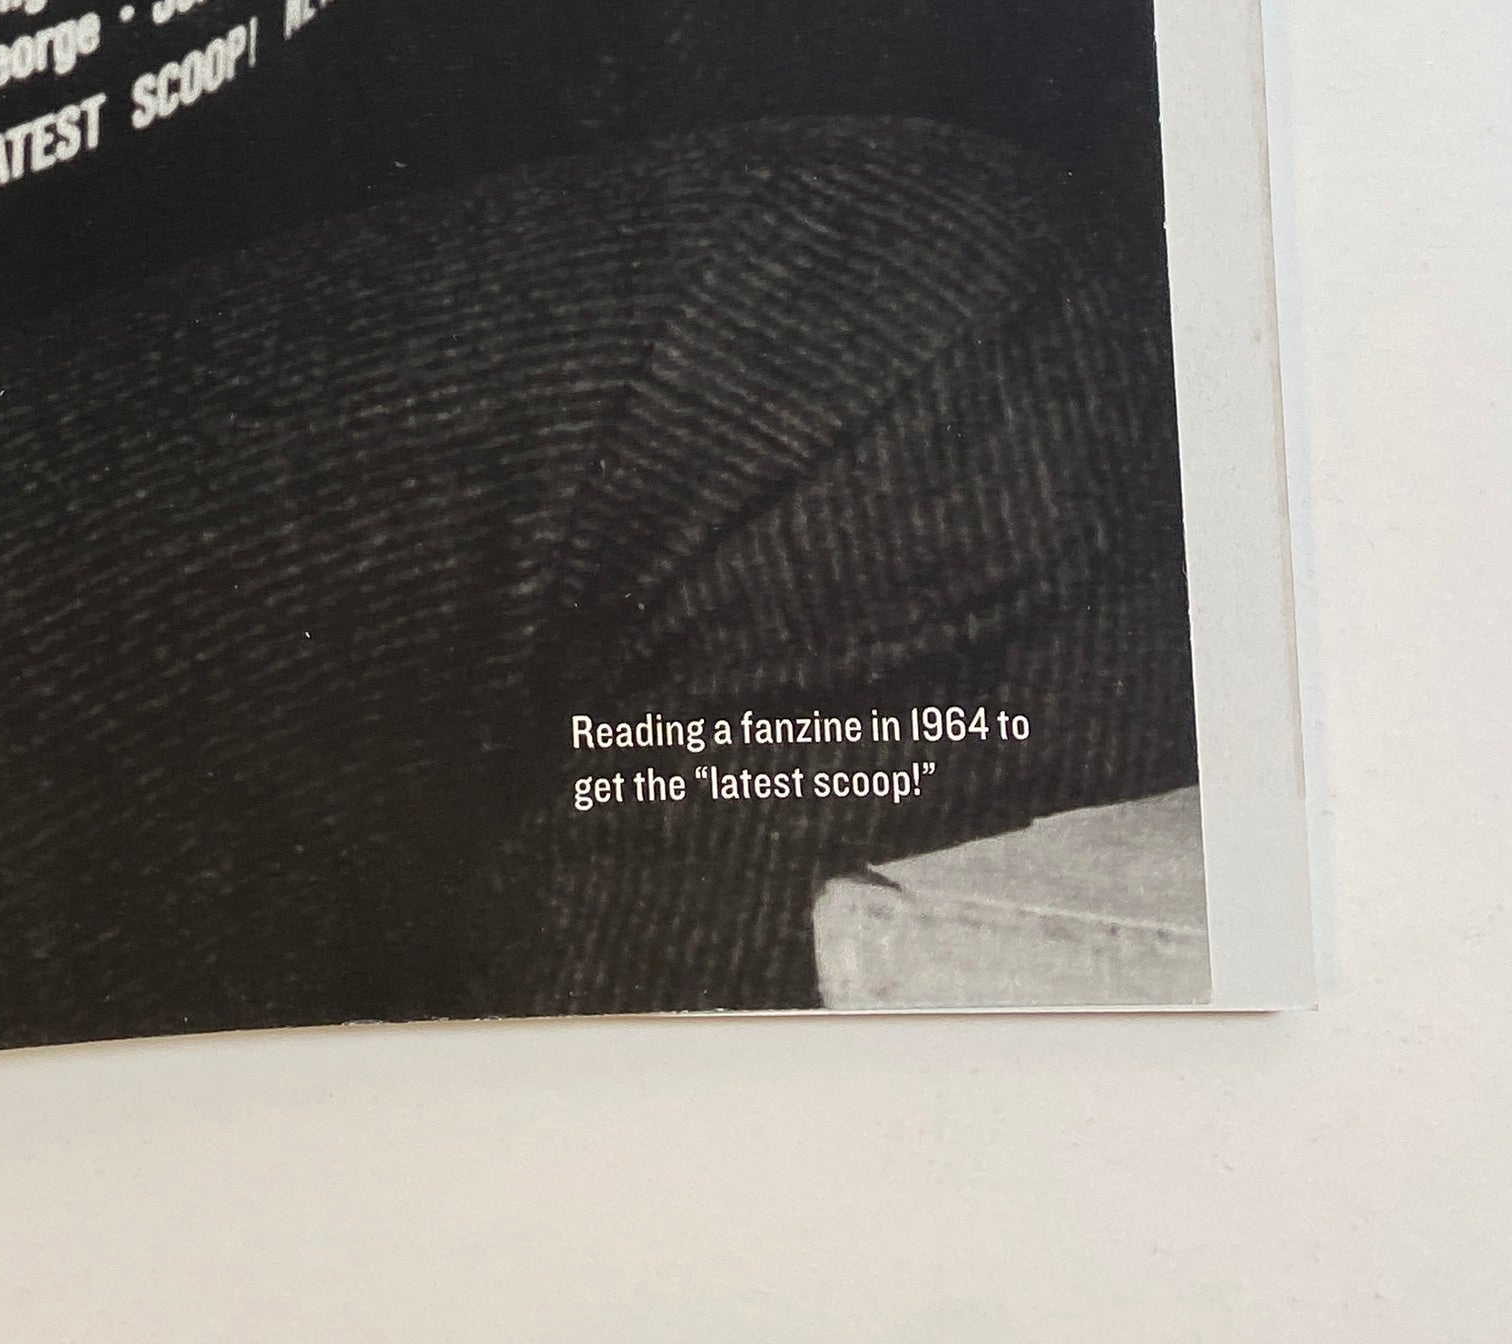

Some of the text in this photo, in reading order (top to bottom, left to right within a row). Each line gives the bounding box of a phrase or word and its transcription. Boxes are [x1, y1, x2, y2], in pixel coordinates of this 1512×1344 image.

[131, 17, 258, 130] SCOOP!
[571, 706, 1030, 753] Reading a fanzine in 1964 to
[573, 771, 625, 810] get
[633, 766, 686, 800] the
